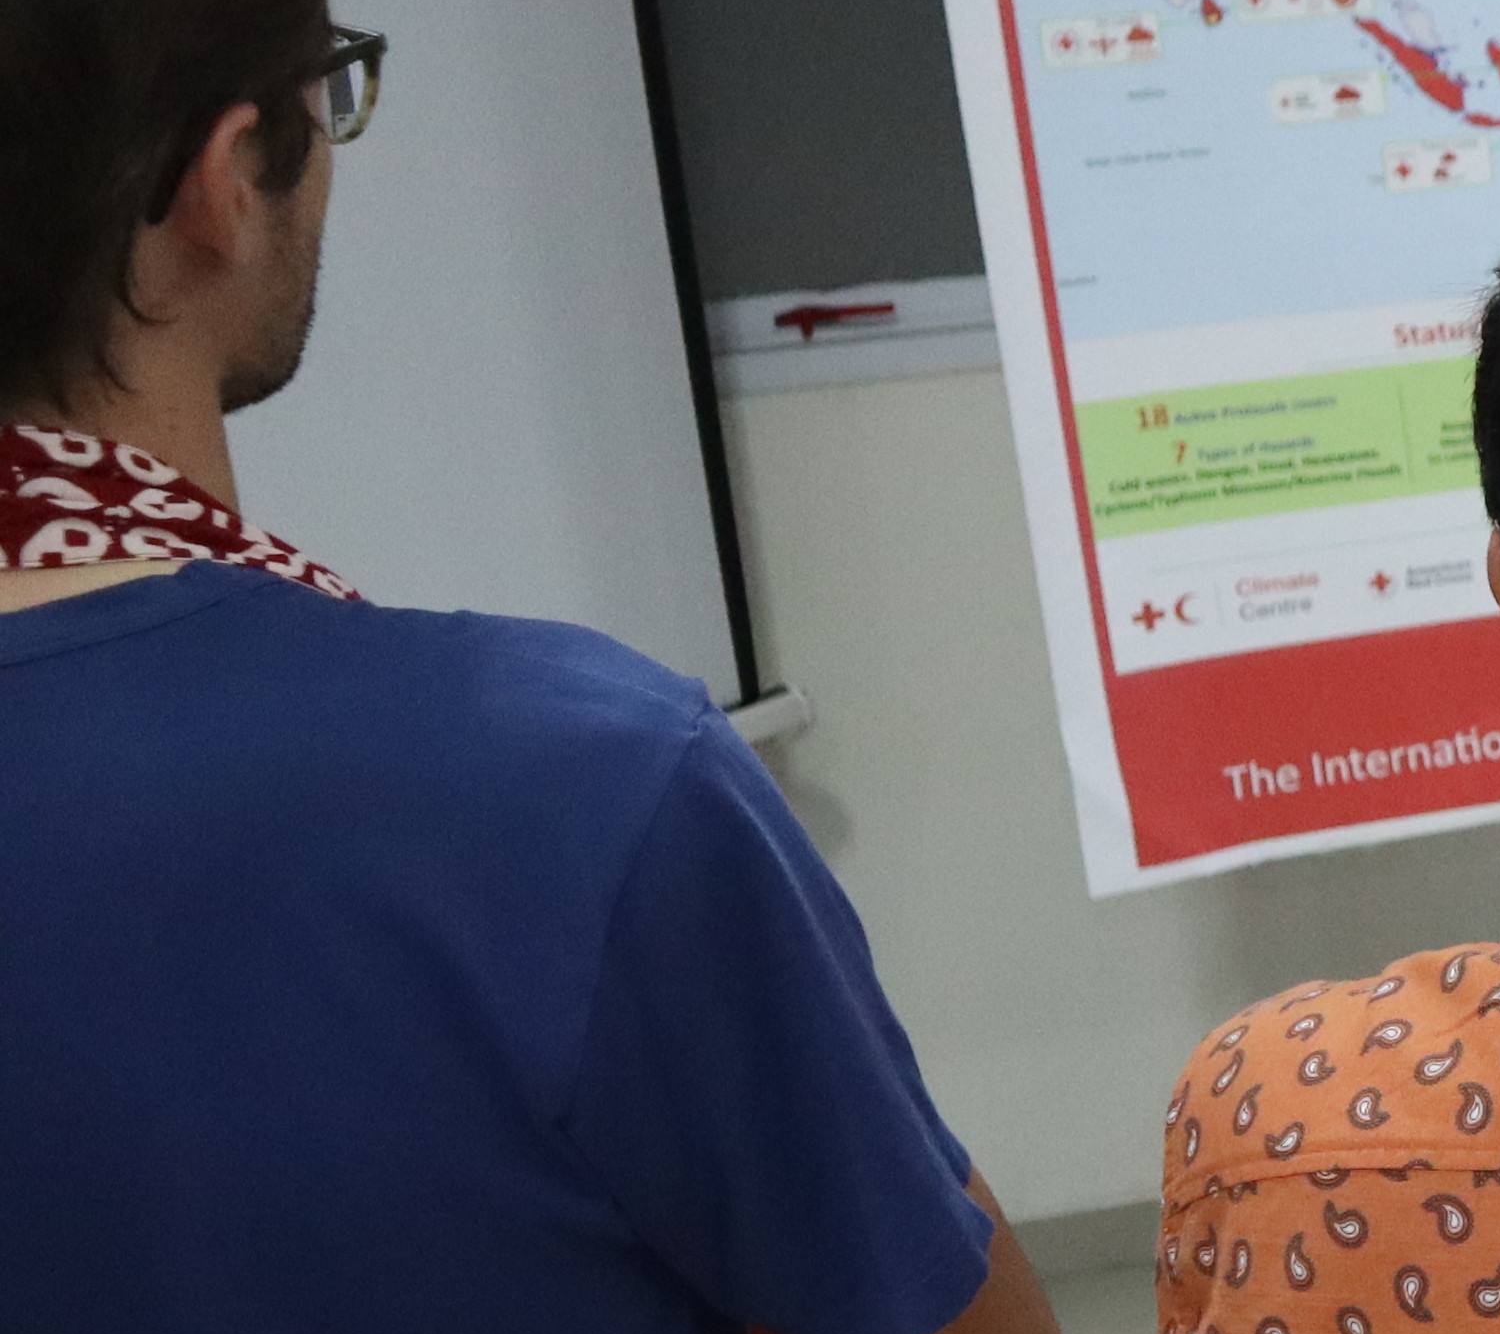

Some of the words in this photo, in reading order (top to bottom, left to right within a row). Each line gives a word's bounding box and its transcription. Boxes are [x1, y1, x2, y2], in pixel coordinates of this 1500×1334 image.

[1236, 572, 1319, 598] Climate
[1239, 597, 1313, 622] Centre
[1222, 758, 1302, 802] The
